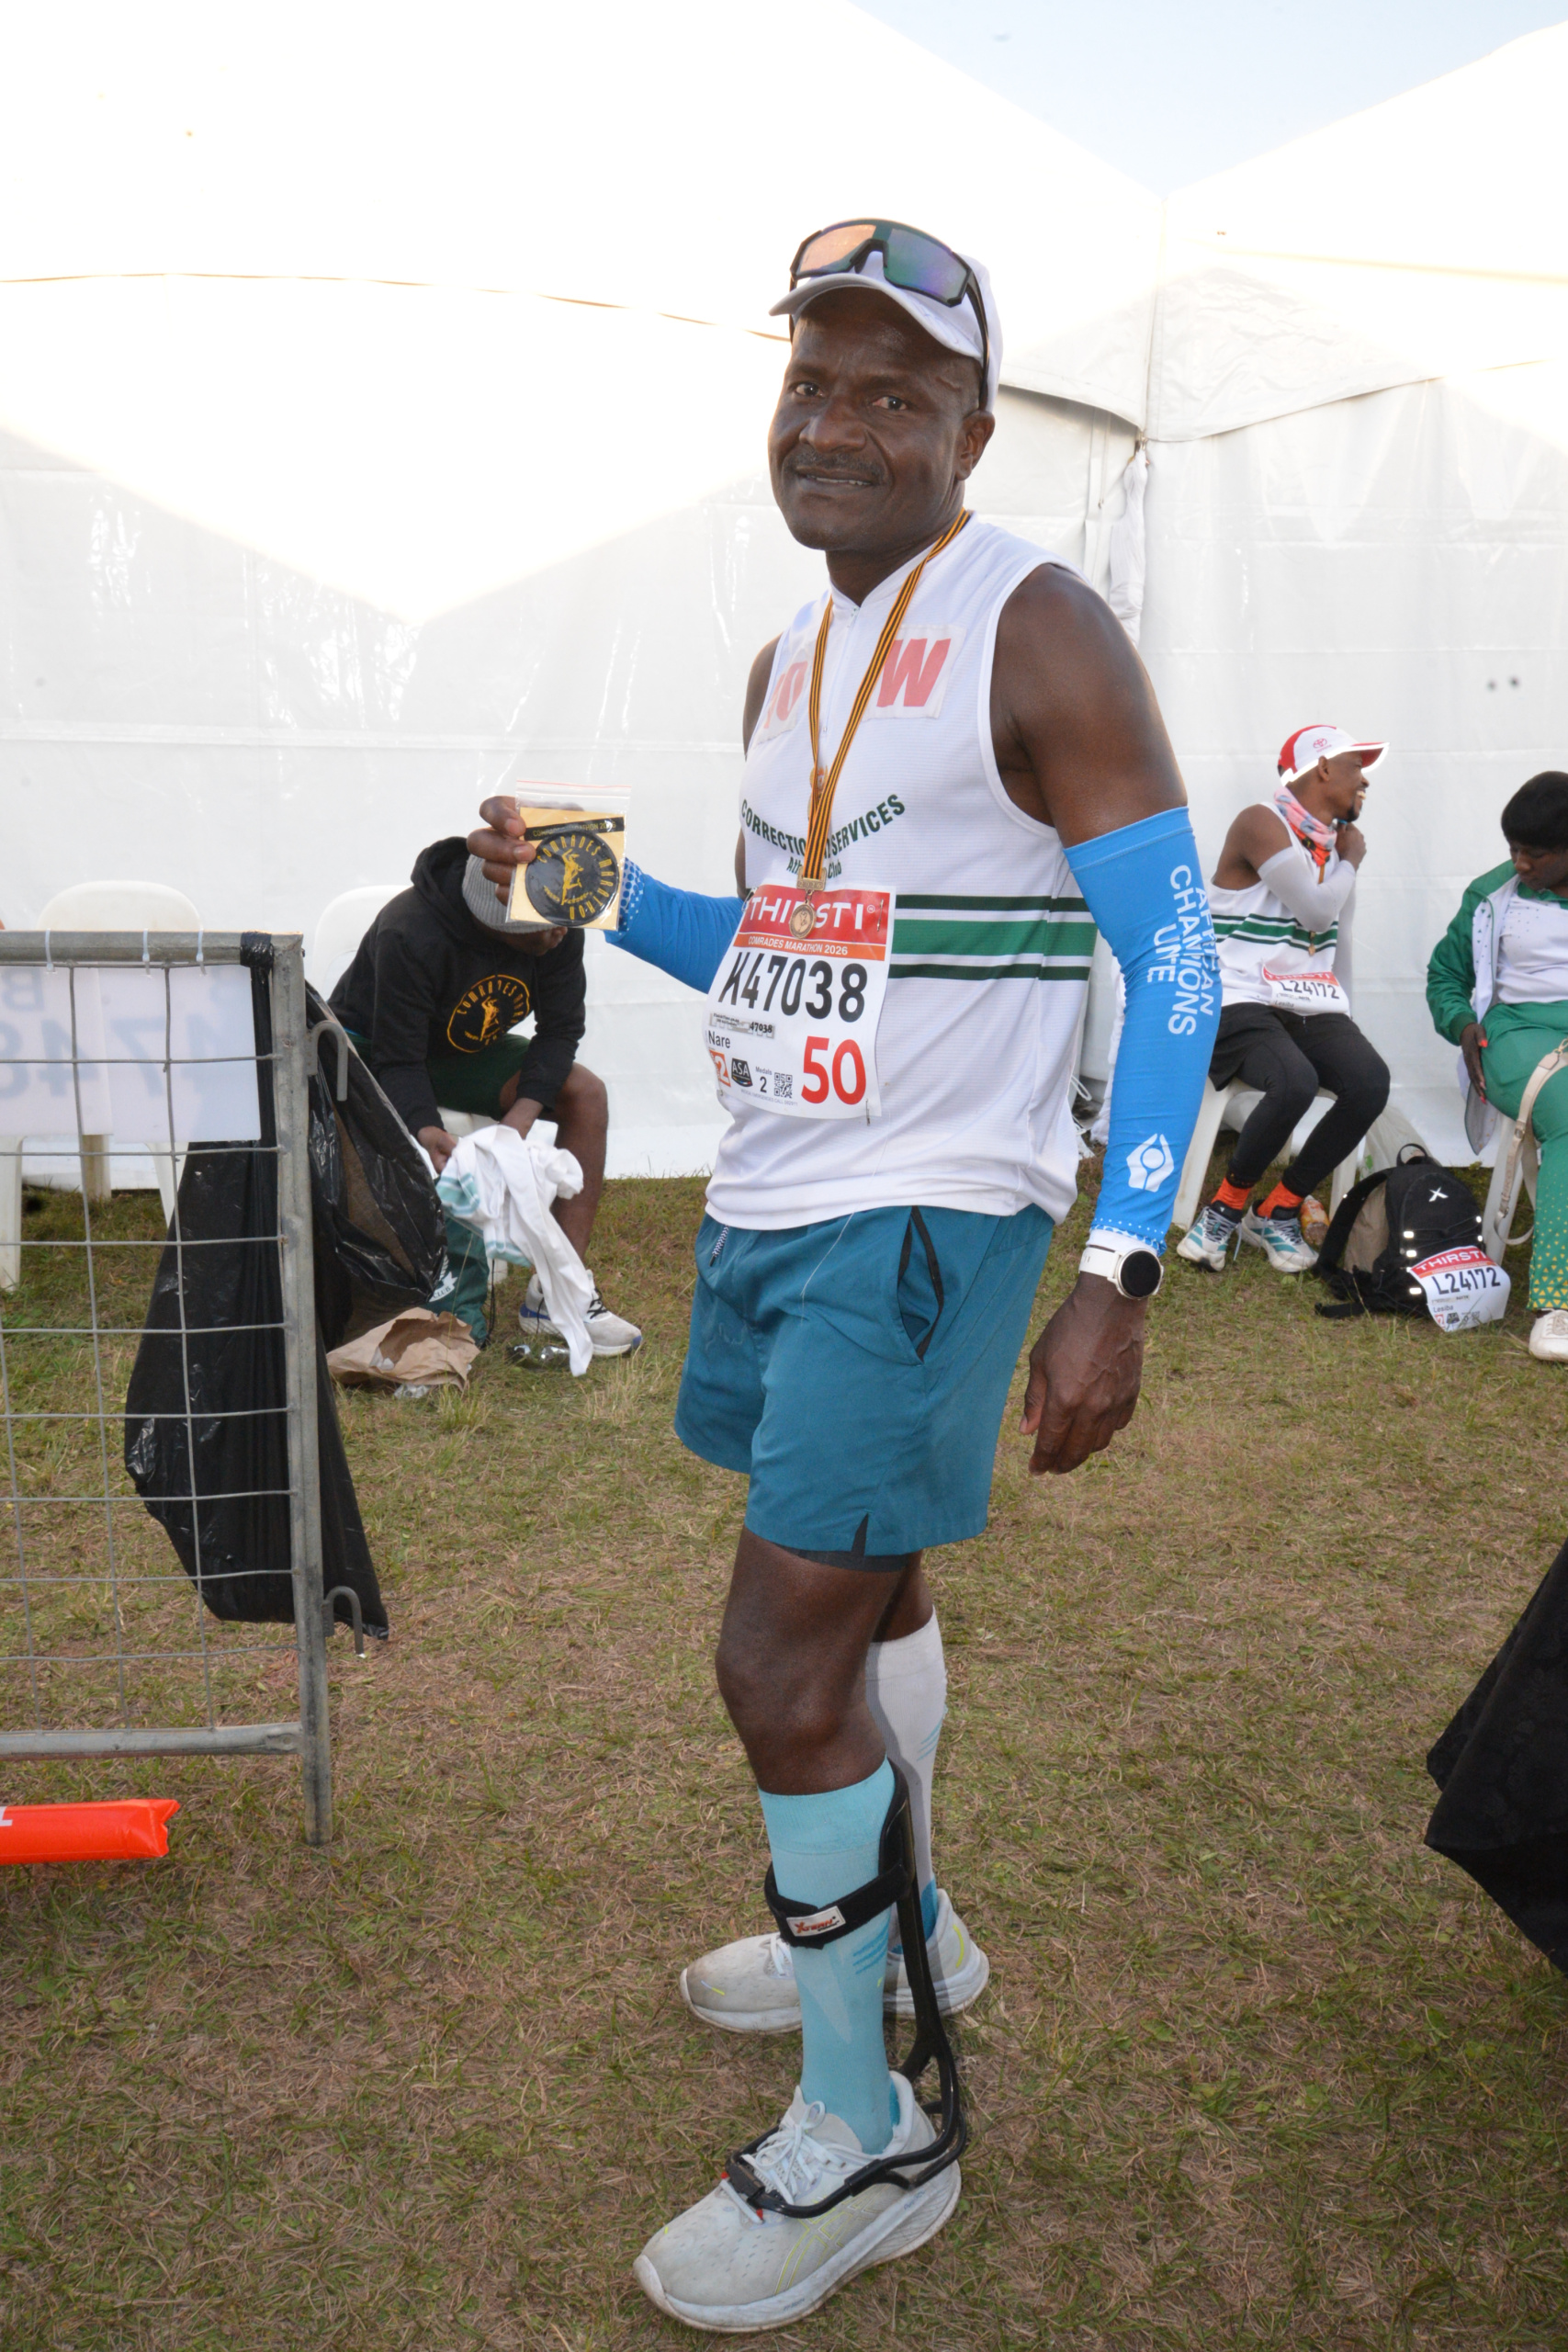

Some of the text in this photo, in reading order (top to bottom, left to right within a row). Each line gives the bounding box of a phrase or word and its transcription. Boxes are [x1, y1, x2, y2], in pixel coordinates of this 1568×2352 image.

[876, 638, 951, 707] W
[832, 794, 906, 855] SERVICES
[537, 834, 602, 863] COMRADES
[570, 858, 615, 921] MARATHON
[828, 860, 842, 879] Club
[748, 935, 848, 956] COMRADES MARATHON 2026
[718, 952, 868, 1023] K47038
[1278, 980, 1340, 1000] L24172
[750, 1021, 773, 1034] 47038
[708, 1030, 730, 1049] Nare
[732, 1061, 750, 1077] ASA
[755, 1066, 773, 1076] Medals
[801, 1035, 867, 1106] 50
[760, 1076, 767, 1093] 2
[1416, 1250, 1487, 1271] THIRSTI
[1431, 1267, 1501, 1295] L24172
[433, 1286, 451, 1298] CLUB
